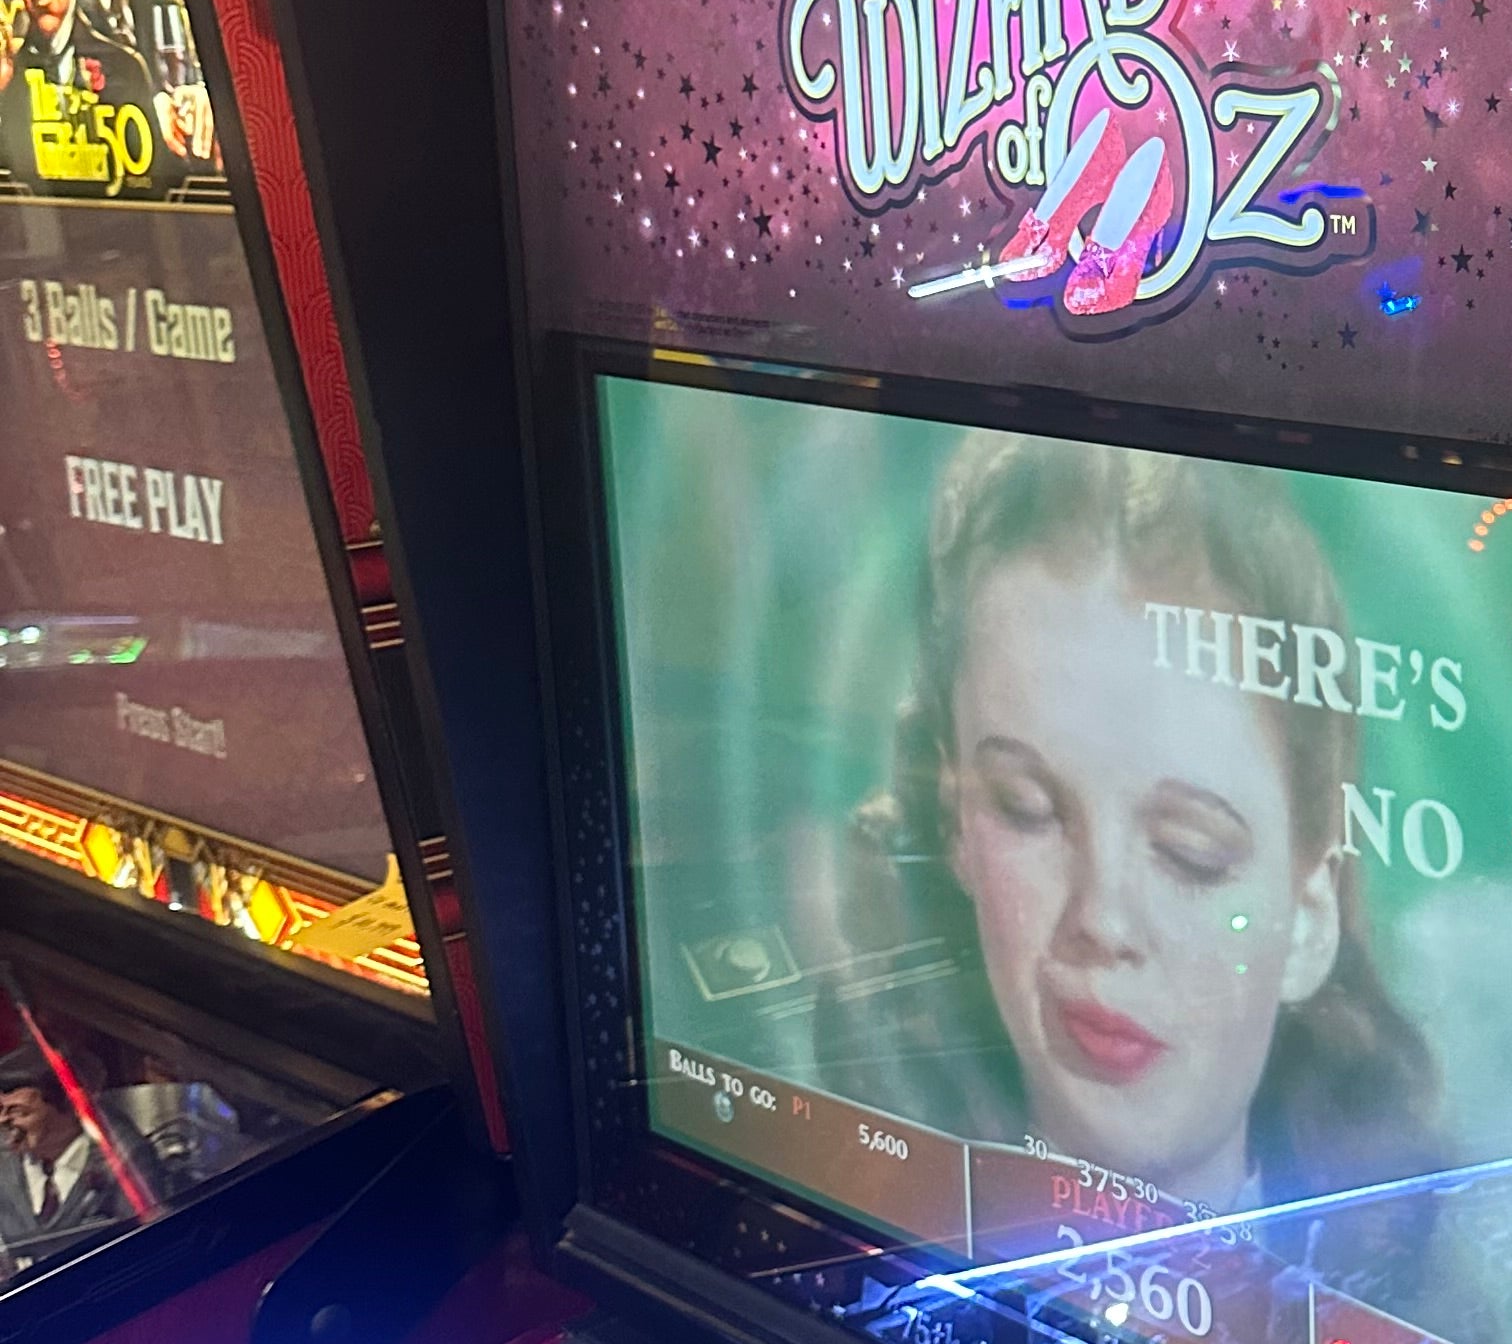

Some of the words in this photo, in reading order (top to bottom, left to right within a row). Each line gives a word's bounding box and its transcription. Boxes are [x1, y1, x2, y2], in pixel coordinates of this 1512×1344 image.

[93, 103, 154, 197] 50
[999, 75, 1053, 185] of
[21, 280, 42, 342] 3
[48, 281, 118, 351] Balls
[144, 288, 236, 364] Game
[65, 455, 141, 530] FREE
[147, 472, 224, 545] PLAY
[1144, 602, 1468, 732] THERE'S
[1340, 782, 1463, 879] NO
[721, 1073, 744, 1097] TO
[858, 1123, 909, 1161] 5,600
[1023, 1134, 1048, 1161] 30
[1133, 1177, 1159, 1204] 30
[1056, 1224, 1213, 1337] 2,560
